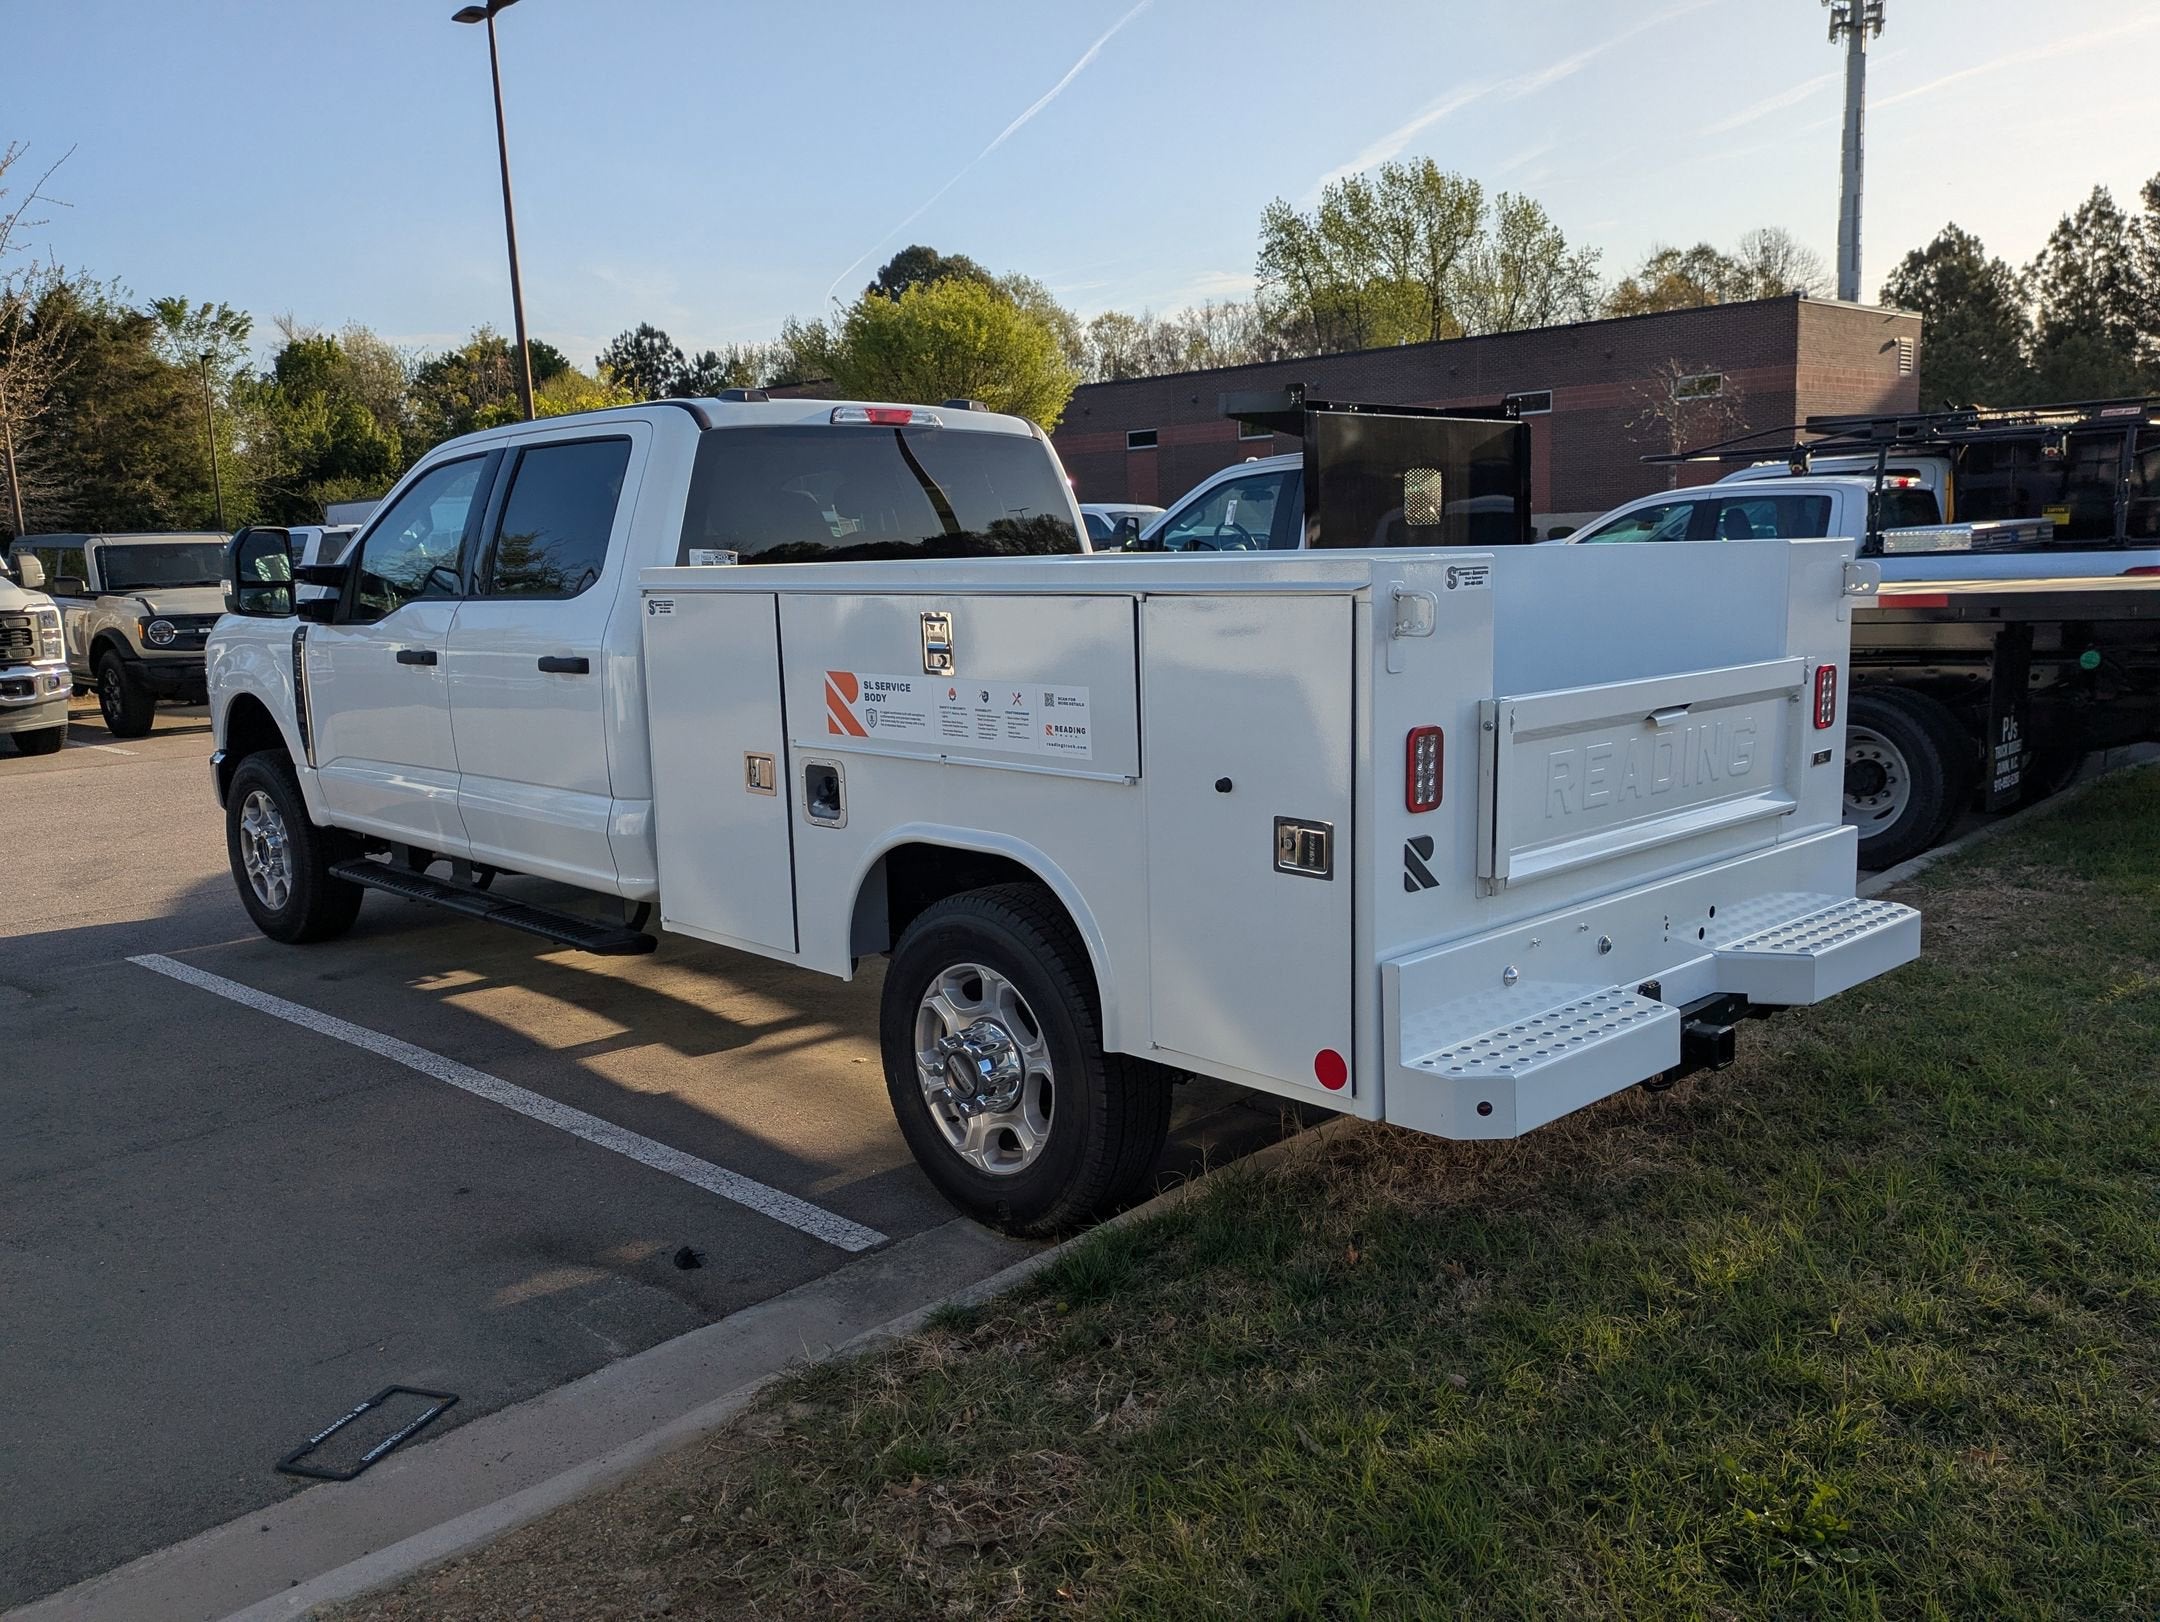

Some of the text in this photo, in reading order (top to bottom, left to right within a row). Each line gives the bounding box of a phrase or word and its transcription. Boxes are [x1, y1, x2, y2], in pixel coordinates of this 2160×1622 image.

[864, 681, 911, 693] SL SERVICE
[865, 692, 887, 702] BODY
[1055, 725, 1086, 734] READING
[1545, 717, 1758, 819] READING
[354, 1402, 370, 1413] MN
